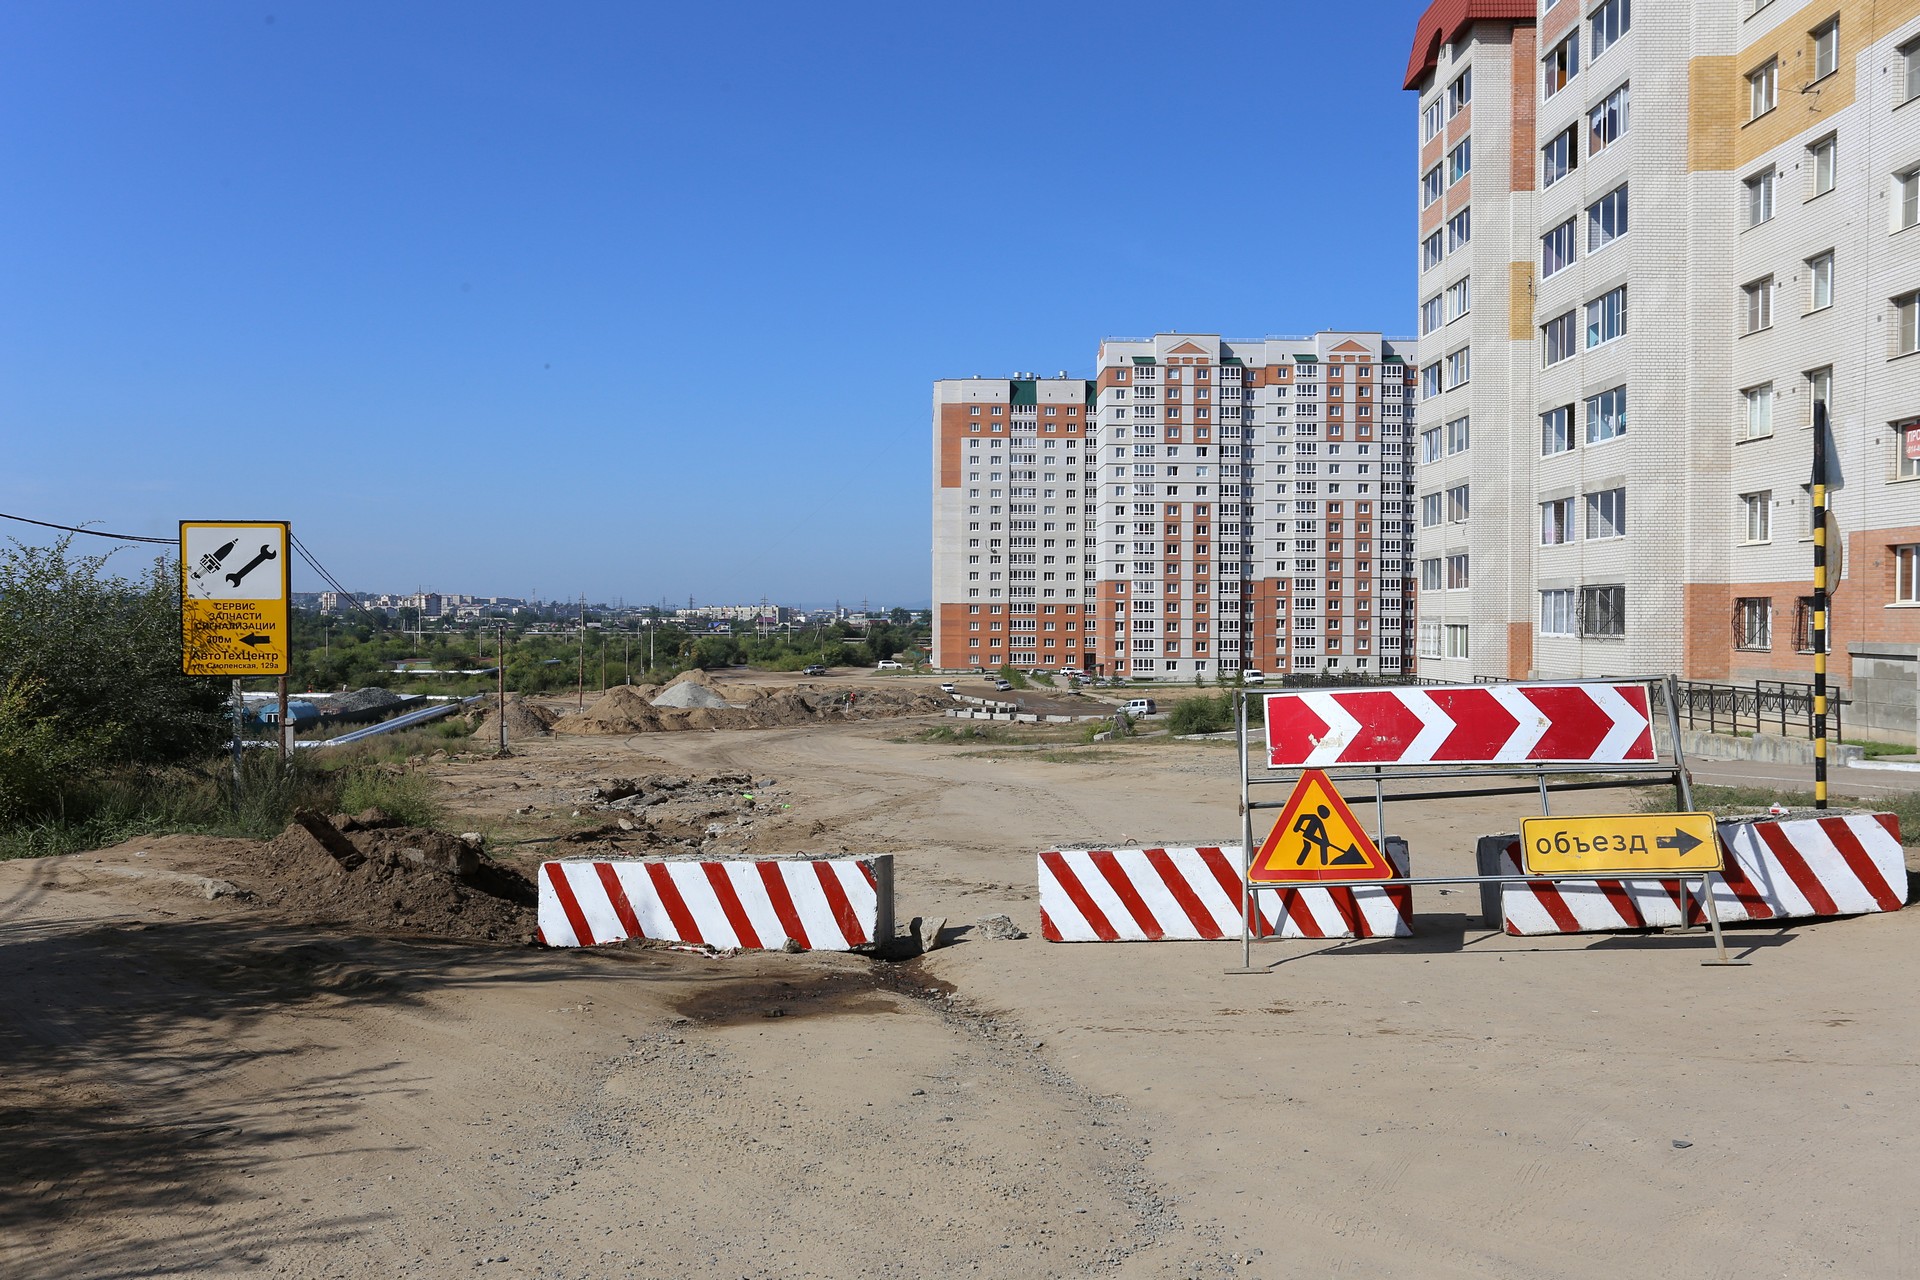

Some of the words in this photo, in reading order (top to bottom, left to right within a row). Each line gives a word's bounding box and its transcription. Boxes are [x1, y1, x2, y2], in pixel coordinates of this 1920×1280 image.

[215, 602, 256, 611] СЕРВИС
[209, 612, 262, 621] ЗАПЧАСТИ
[195, 622, 276, 631] СИГНАЛИЗАЦИИ
[206, 635, 232, 644] 300м
[191, 650, 279, 662] АвтоТехЦентр
[1536, 831, 1648, 855] объезд
